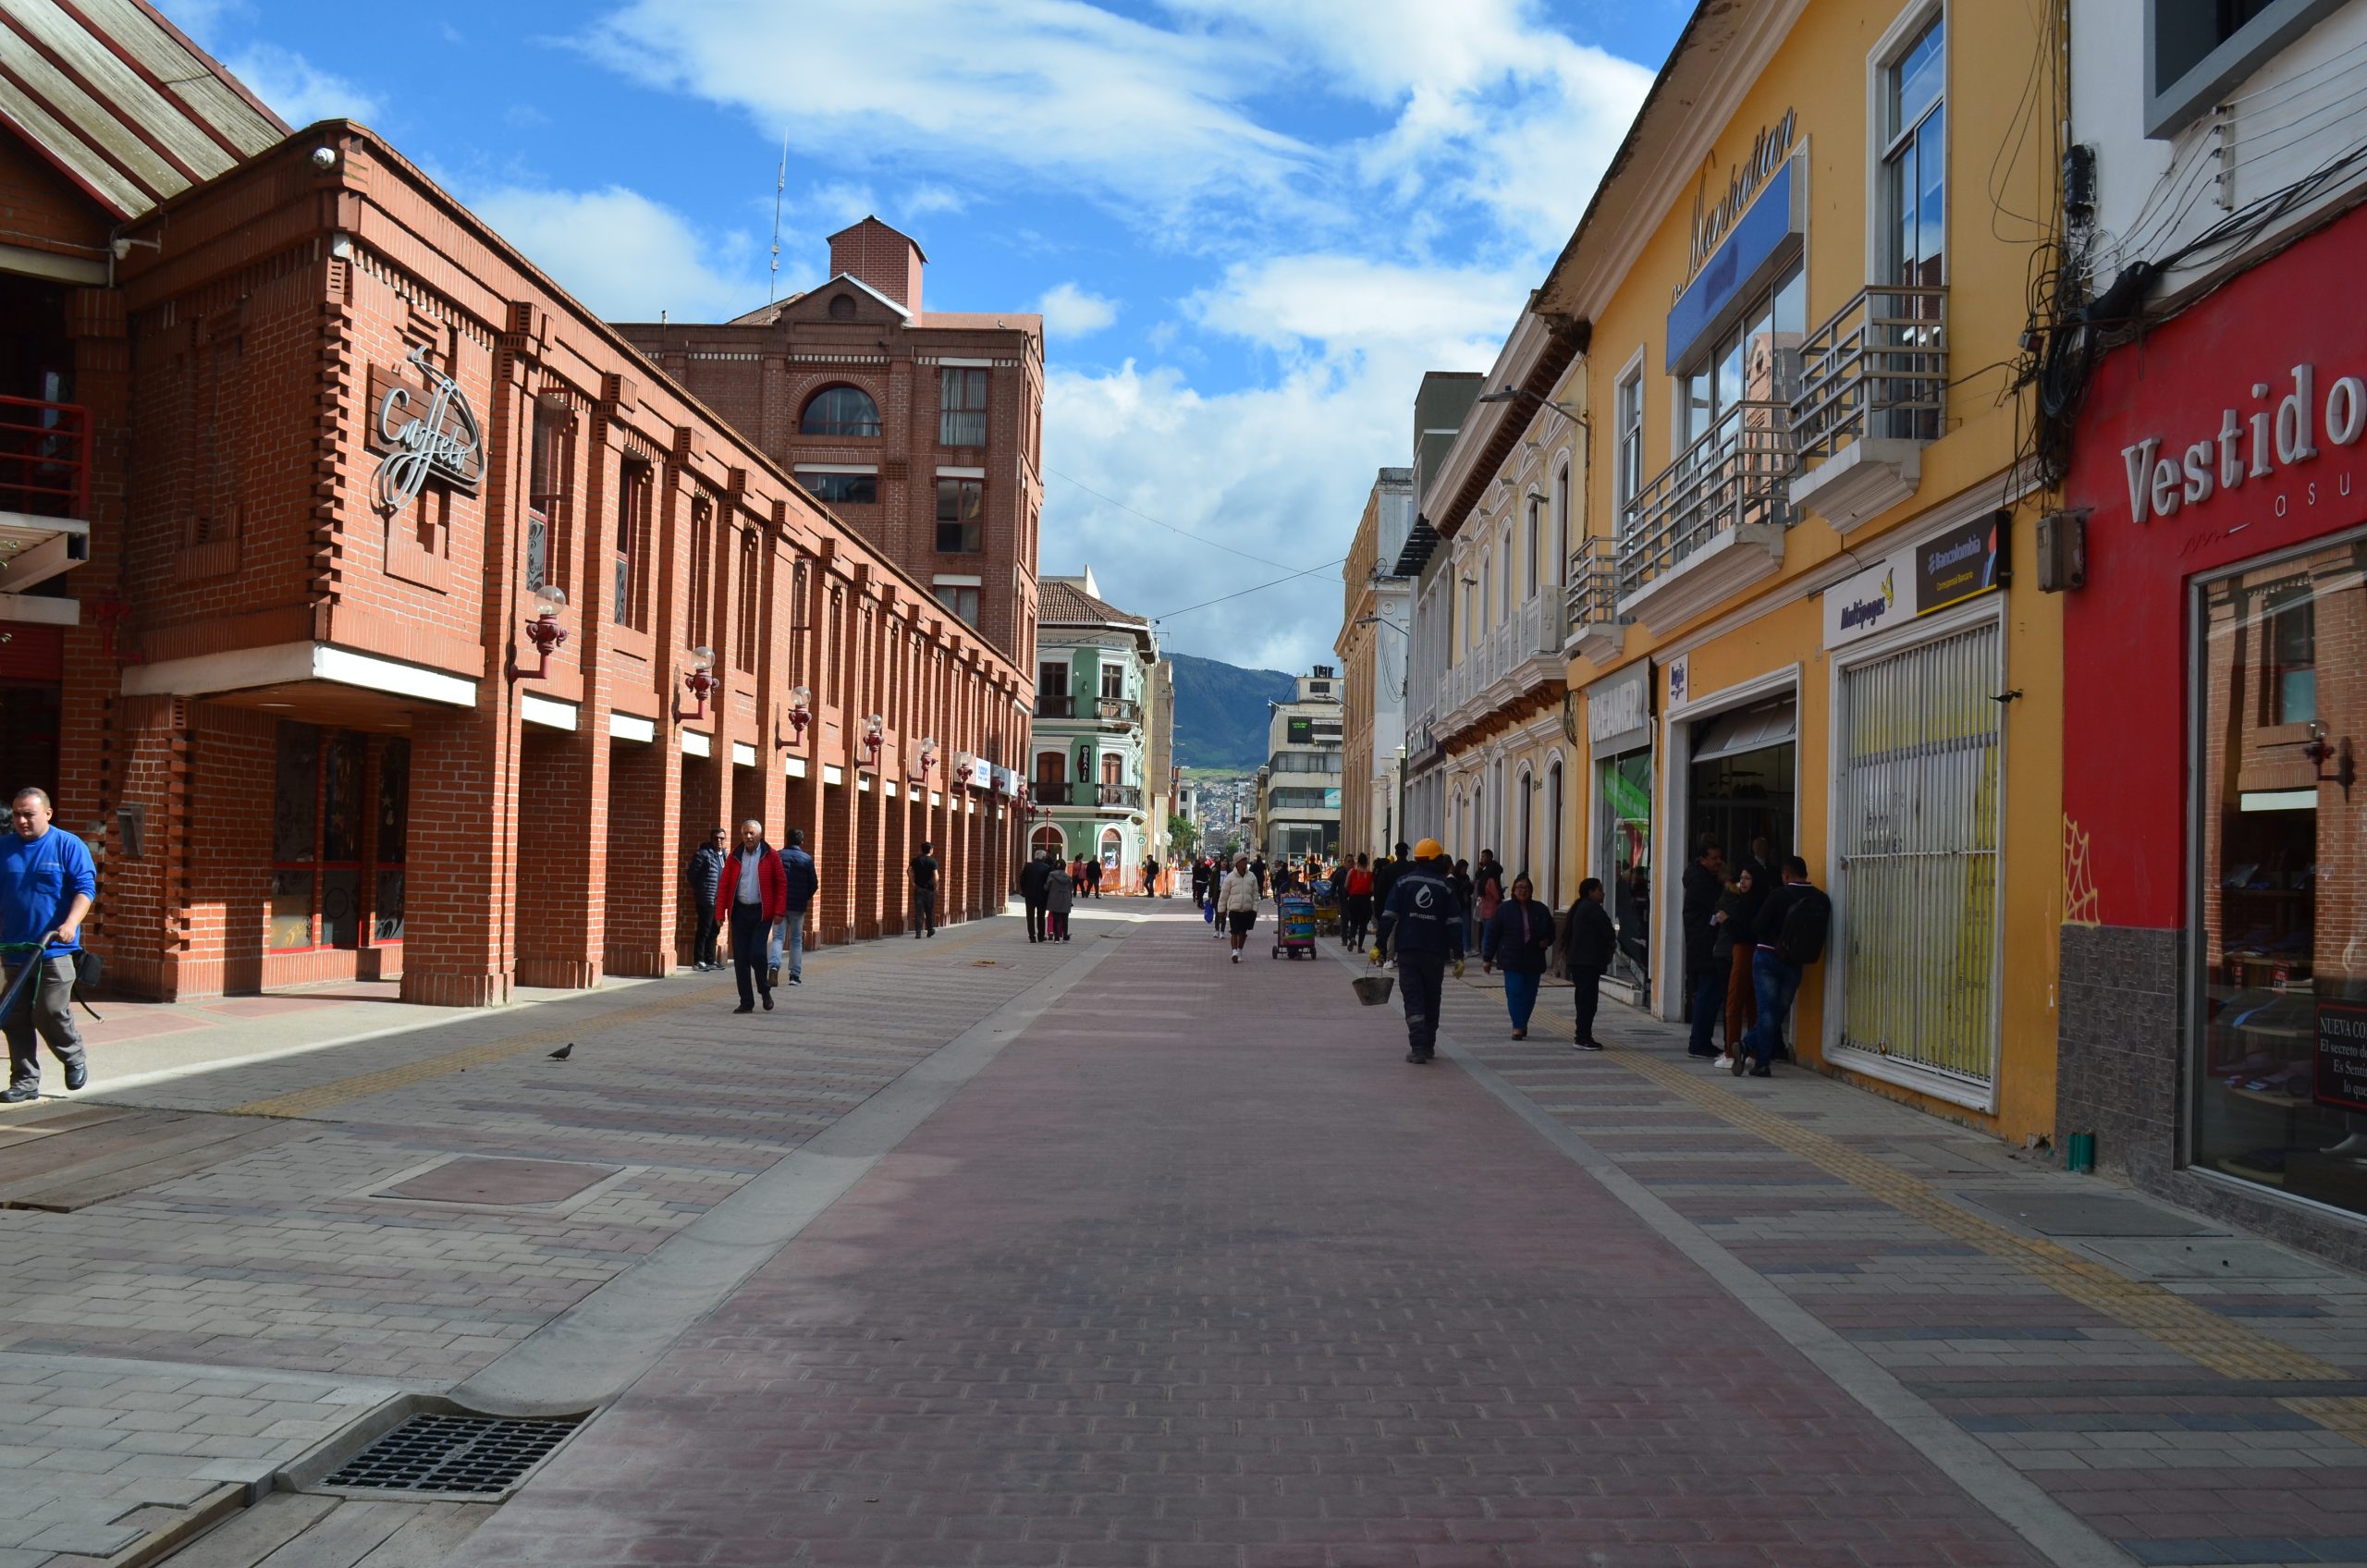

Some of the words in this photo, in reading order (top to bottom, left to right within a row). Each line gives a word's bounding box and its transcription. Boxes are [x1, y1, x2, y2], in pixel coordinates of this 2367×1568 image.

[1934, 534, 1981, 572] Bancolombia
[2320, 1017, 2351, 1037] NUEVA
[2320, 1038, 2329, 1052] El
[2330, 1043, 2358, 1057] secreto
[2334, 1060, 2344, 1073] Es
[2344, 1080, 2351, 1094] lo
